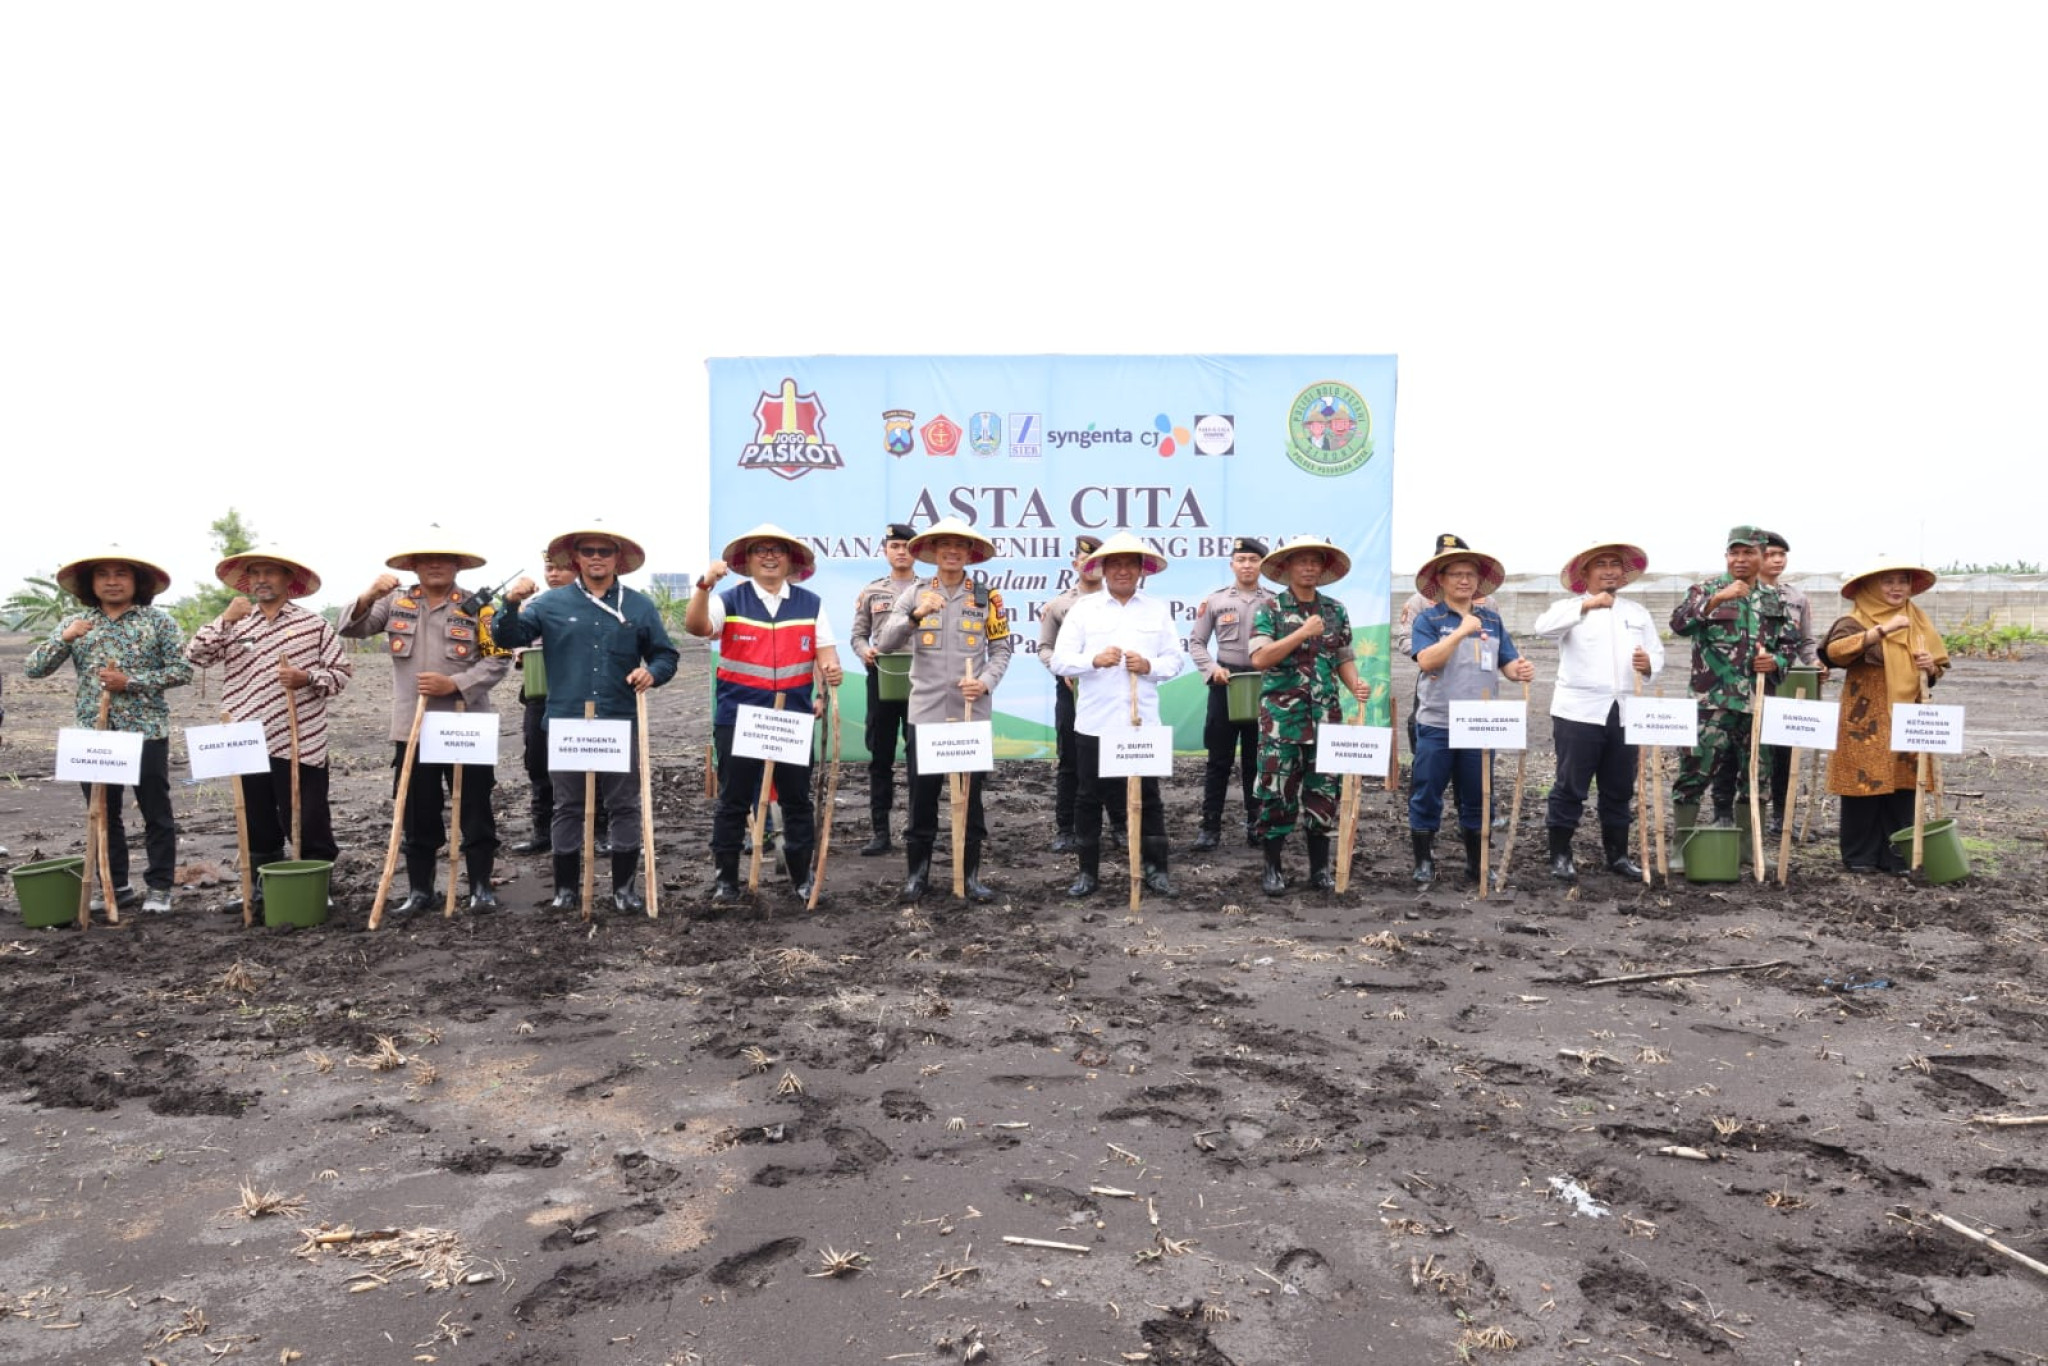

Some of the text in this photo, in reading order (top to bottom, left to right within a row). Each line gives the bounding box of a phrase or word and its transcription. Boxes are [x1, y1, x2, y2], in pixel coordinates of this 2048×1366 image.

[776, 433, 805, 443] JOGO
[1047, 428, 1133, 448] syngenta
[1140, 431, 1160, 448] CJ
[740, 444, 838, 464] PASKOT
[908, 486, 1209, 529] ASTA CITA
[755, 723, 795, 735] INDUSTRIAL
[577, 736, 617, 744] SYNGENTA
[743, 731, 769, 741] ESTATE
[199, 739, 259, 751] CAMAT KRATON
[444, 740, 476, 748] KRATON
[580, 746, 621, 754] INDONESIA
[936, 749, 976, 757] PASURUAN
